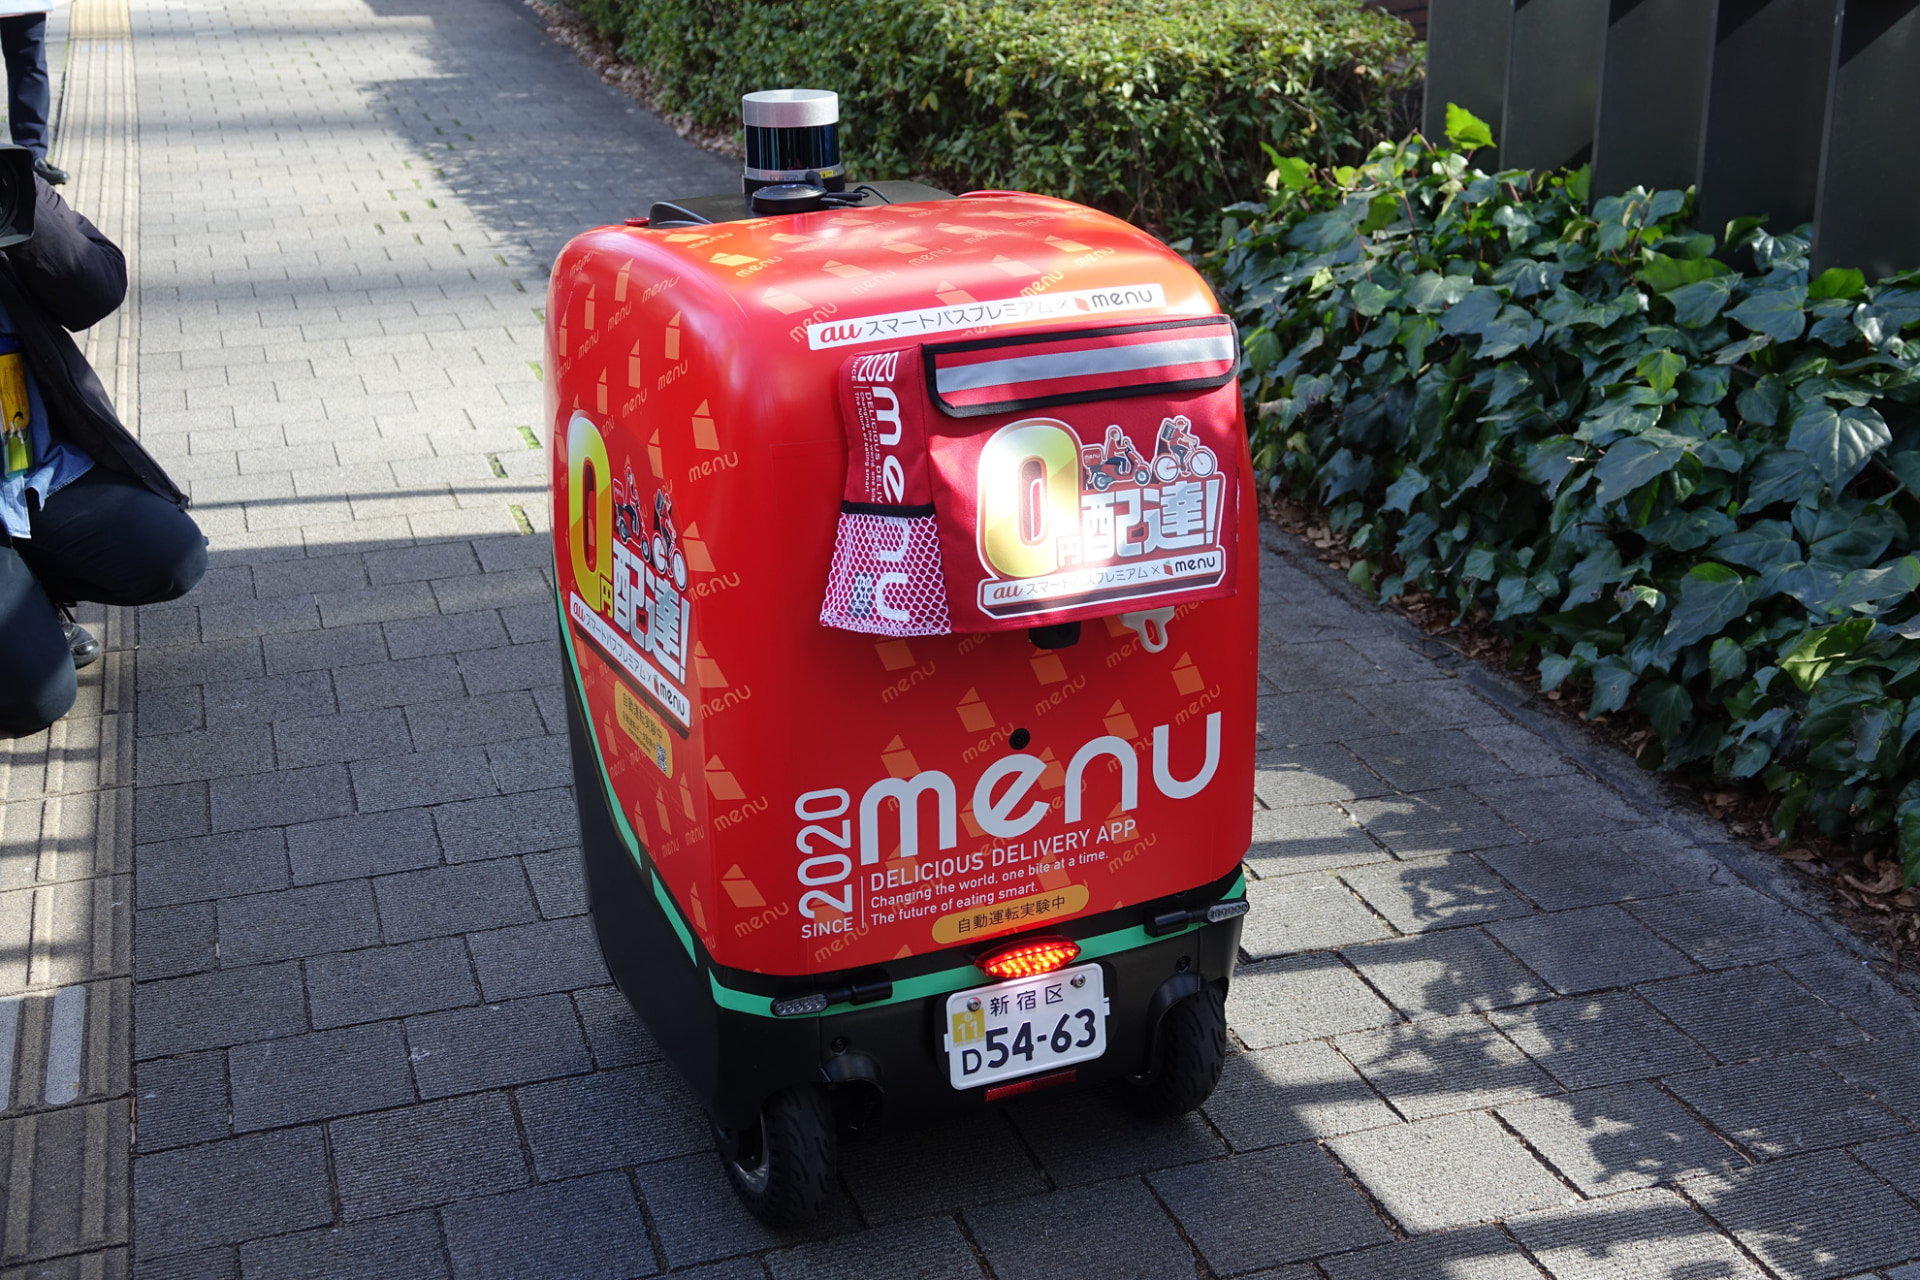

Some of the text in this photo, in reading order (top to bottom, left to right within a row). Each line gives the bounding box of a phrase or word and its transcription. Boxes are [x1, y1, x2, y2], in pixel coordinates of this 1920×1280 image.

[687, 232, 733, 249] menu
[908, 246, 952, 266] menu
[1073, 246, 1115, 268] menu
[736, 255, 783, 278] menu
[849, 270, 897, 297] menu
[1020, 269, 1064, 298] menu
[642, 275, 680, 303] menu
[607, 300, 632, 332] menu
[820, 323, 862, 343] au
[866, 301, 1053, 337] スマートパスプレミアム
[1091, 288, 1153, 308] menu
[578, 329, 599, 360] menu
[657, 359, 689, 392] menu
[857, 351, 900, 382] 2020
[622, 387, 648, 419] menu
[601, 414, 615, 438] enu
[865, 391, 884, 505] DELICIOUS DELIV
[688, 451, 739, 483] menu
[993, 584, 1024, 600] au
[1175, 554, 1216, 573] menu
[573, 601, 586, 622] au
[659, 682, 685, 717] menu
[881, 660, 937, 703] menu
[1035, 673, 1087, 716] menu
[700, 684, 751, 720] menu
[1174, 683, 1221, 726] menu
[961, 721, 1016, 764] menu
[860, 711, 1222, 866] menu
[713, 795, 769, 832] menu
[684, 824, 705, 847] menu
[795, 787, 853, 919] 2020
[1108, 832, 1157, 873] menu
[871, 852, 984, 892] DELICIOUS
[992, 828, 1091, 867] DELIVERY
[1096, 818, 1137, 845] APP
[871, 887, 932, 909] Changing
[935, 882, 955, 896] the
[1002, 869, 1025, 882] one
[1028, 862, 1051, 876] bite
[1053, 859, 1066, 870] at
[1068, 858, 1076, 867] a
[1079, 850, 1109, 865] time.
[734, 901, 789, 937] menu
[871, 910, 895, 926] The
[898, 902, 938, 921] future
[940, 898, 954, 911] of
[956, 891, 995, 908] eating
[998, 881, 1039, 900] smart.
[958, 895, 1066, 934] 自動運転実験中
[801, 917, 854, 939] SINCE
[814, 921, 870, 963] menu
[989, 983, 1064, 1017] 新宿区
[957, 1020, 978, 1041] 11
[985, 1008, 1097, 1069] 54-63
